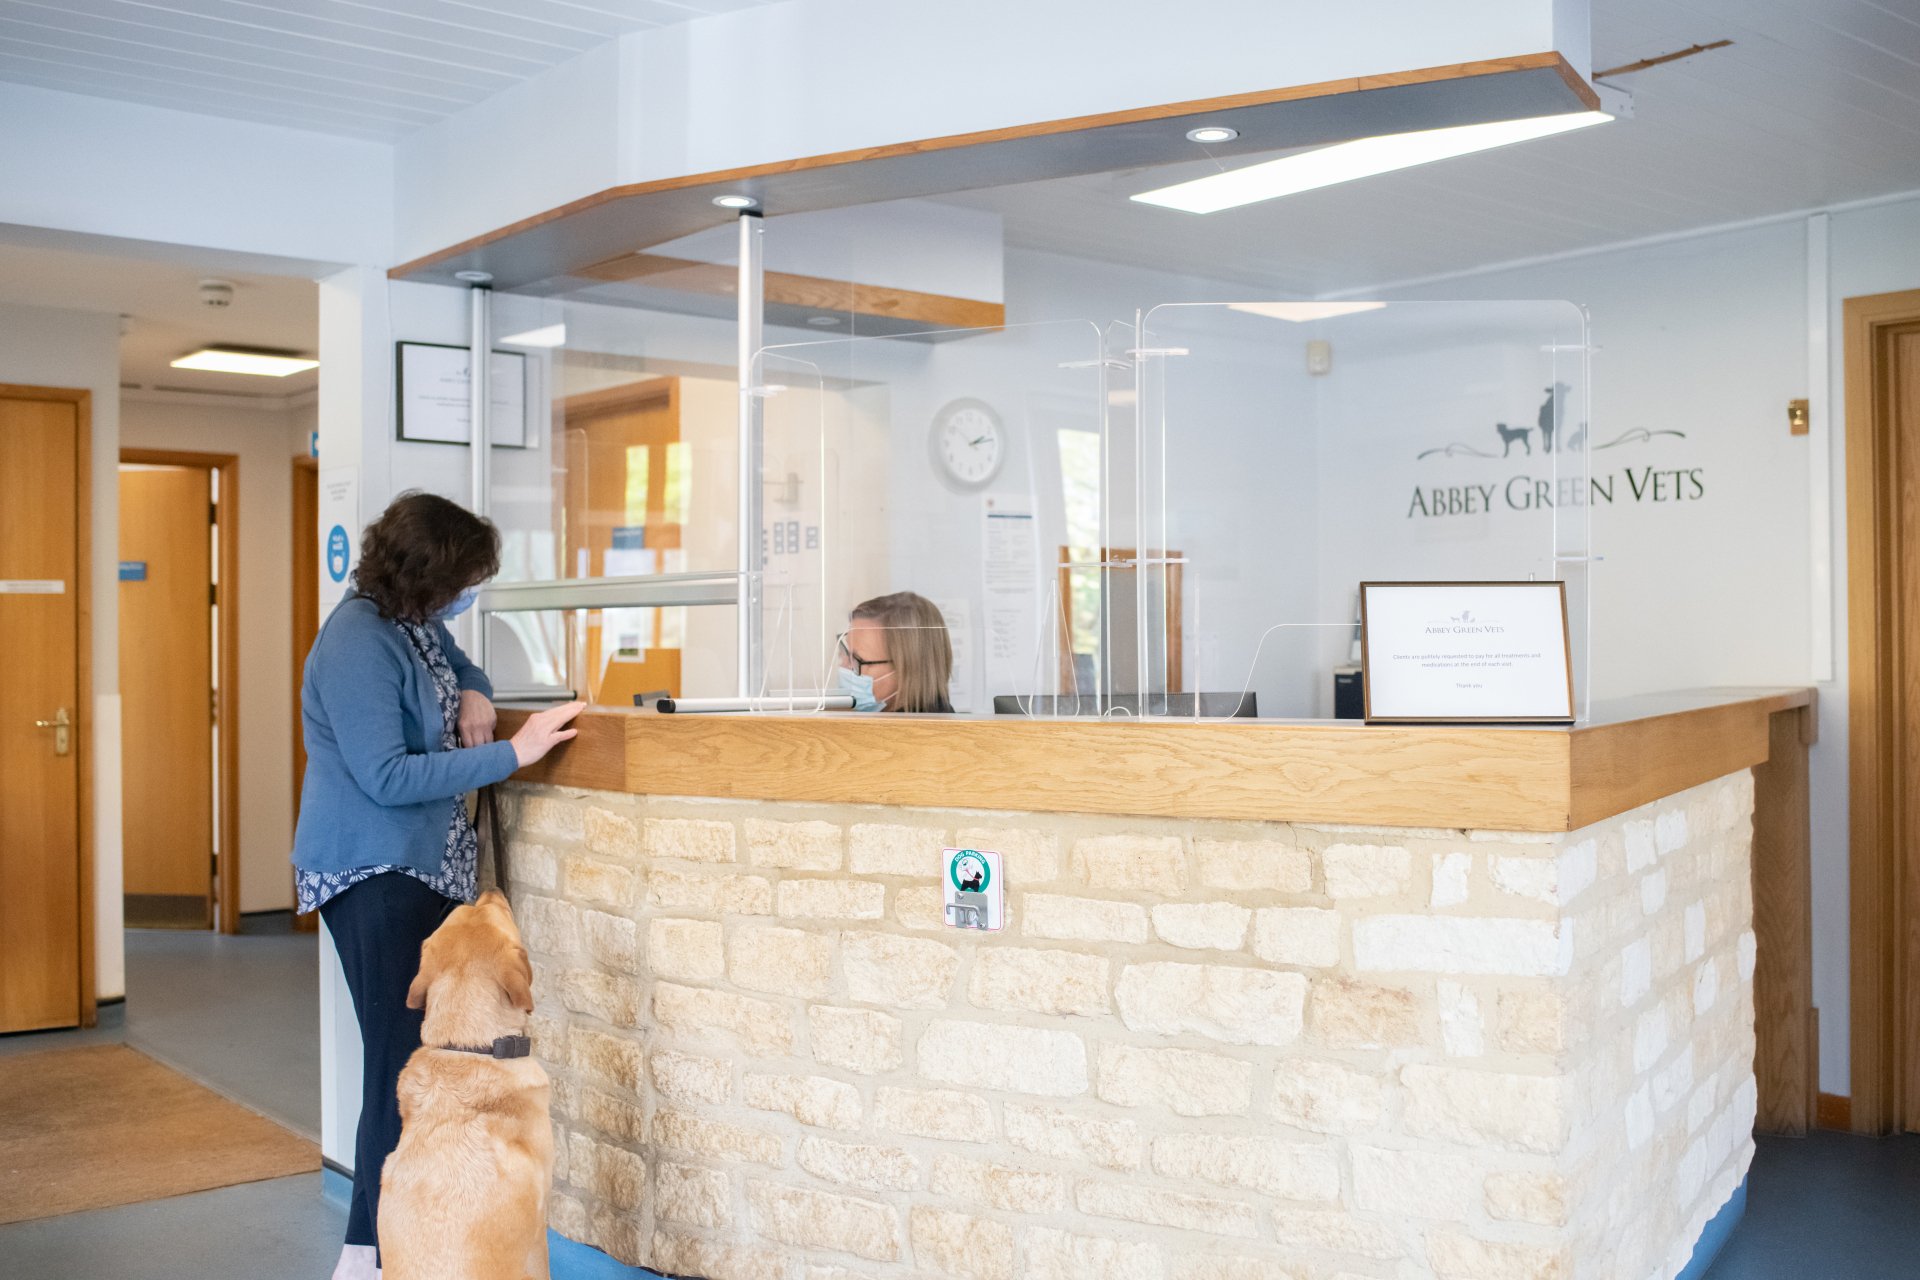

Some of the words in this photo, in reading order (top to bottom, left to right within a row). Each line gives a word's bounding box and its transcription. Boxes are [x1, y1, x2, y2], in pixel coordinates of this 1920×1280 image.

[1408, 484, 1496, 518] ABBEY
[1505, 475, 1613, 510] GREEN
[1624, 466, 1704, 502] VETS
[1425, 626, 1451, 634] ABBEY
[1453, 625, 1483, 634] GREEN
[1484, 625, 1505, 633] VETS
[1421, 653, 1441, 661] politely
[1442, 653, 1467, 661] requested
